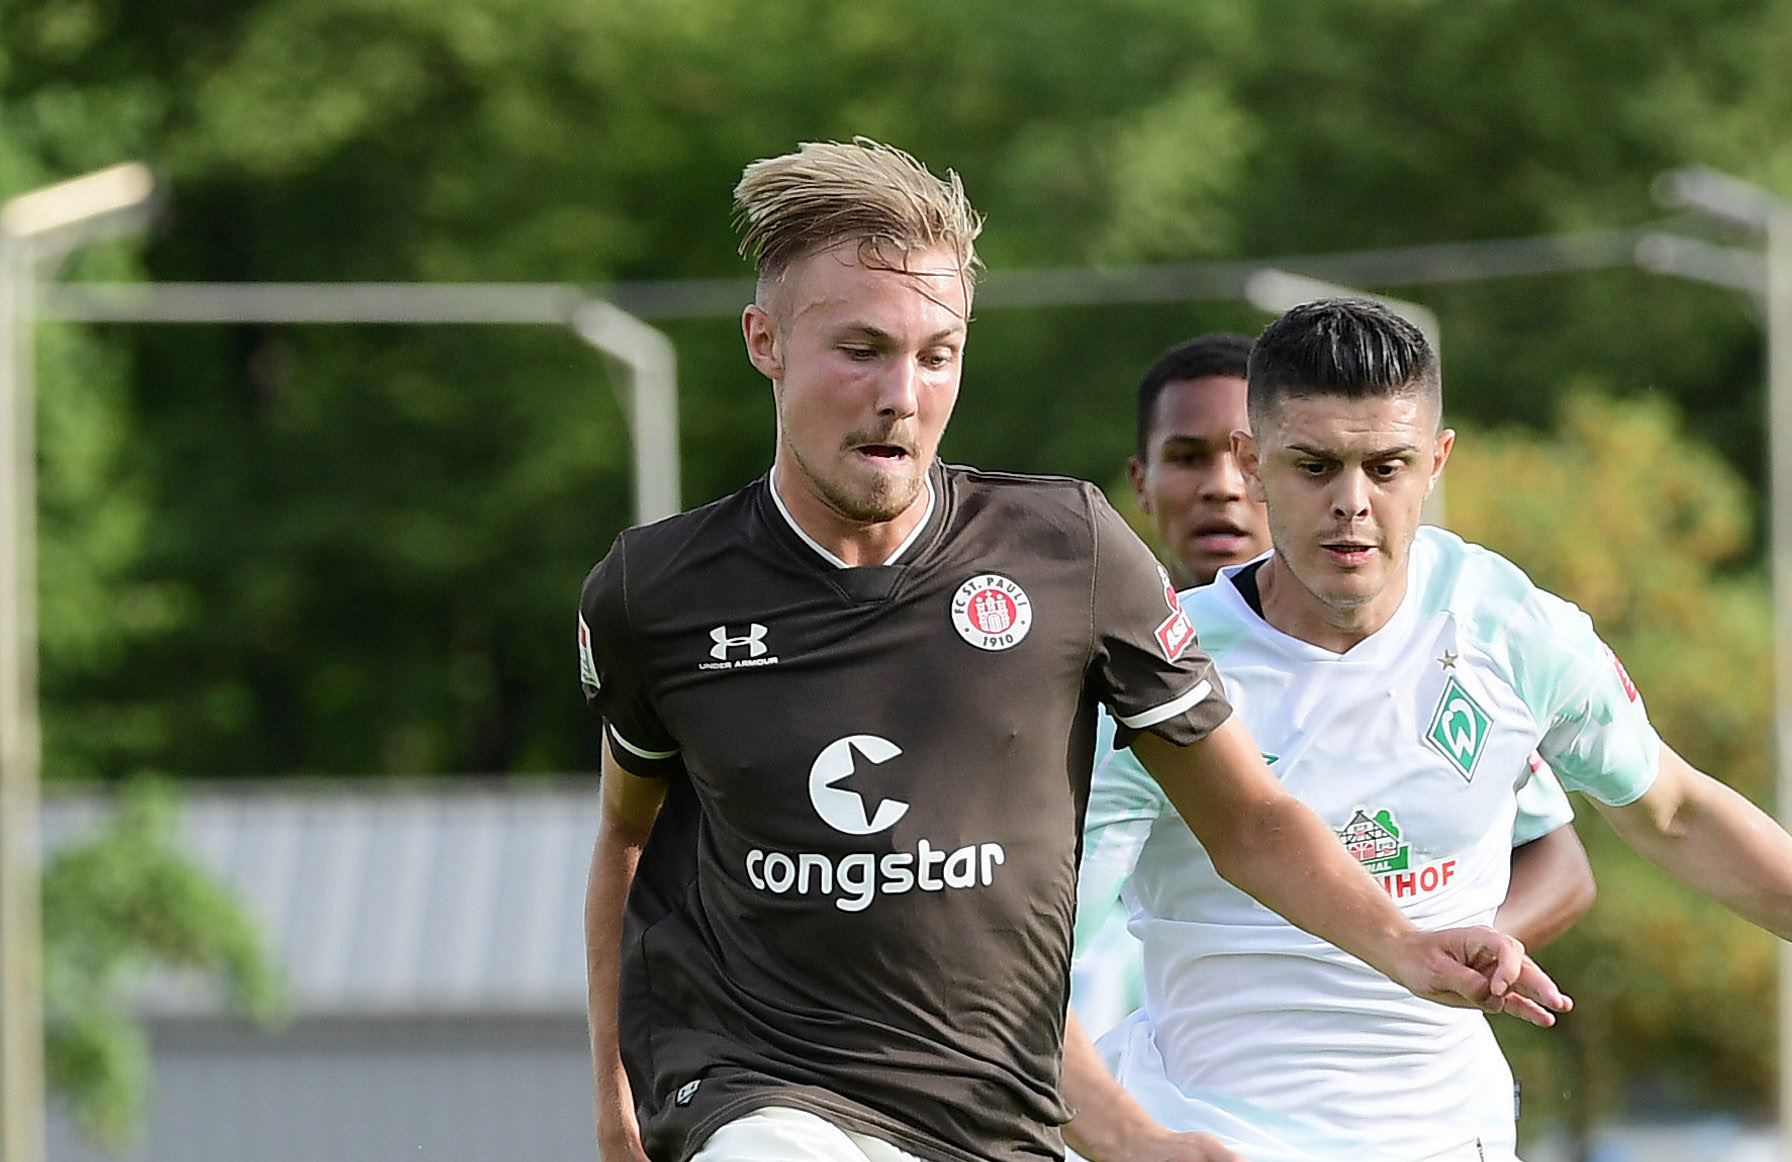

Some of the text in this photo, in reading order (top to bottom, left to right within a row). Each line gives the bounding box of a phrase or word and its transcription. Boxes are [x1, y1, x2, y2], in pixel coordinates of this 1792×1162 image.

[954, 577, 1028, 614] FC ST. PAULI
[982, 634, 1014, 647] 1910
[698, 656, 779, 670] UNDER ARMOUR
[746, 838, 1005, 912] congstar
